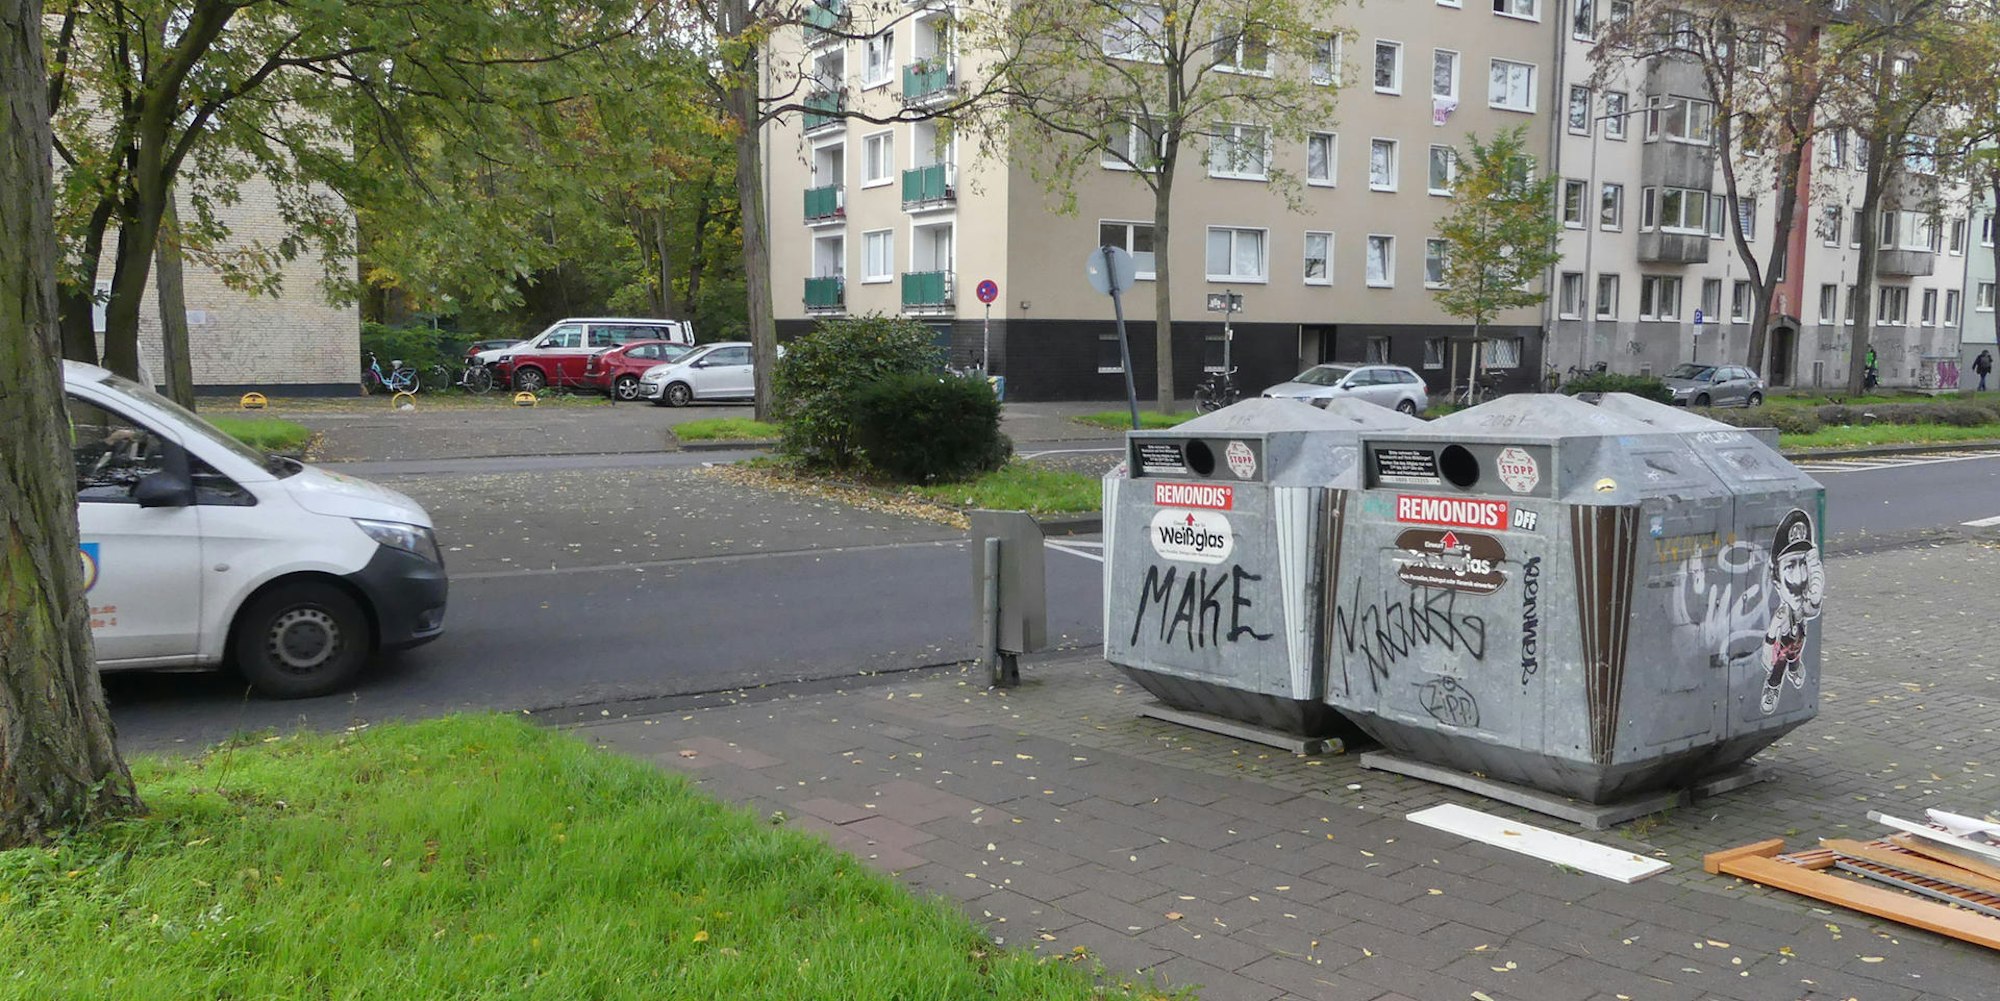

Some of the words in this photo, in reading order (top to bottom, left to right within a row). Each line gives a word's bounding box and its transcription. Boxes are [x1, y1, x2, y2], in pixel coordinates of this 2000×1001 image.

[1229, 455, 1252, 464] STOPP
[1501, 465, 1534, 475] STOPP
[1514, 508, 1537, 530] DFF
[1158, 526, 1224, 552] Weißglas
[1131, 563, 1274, 652] MAKE
